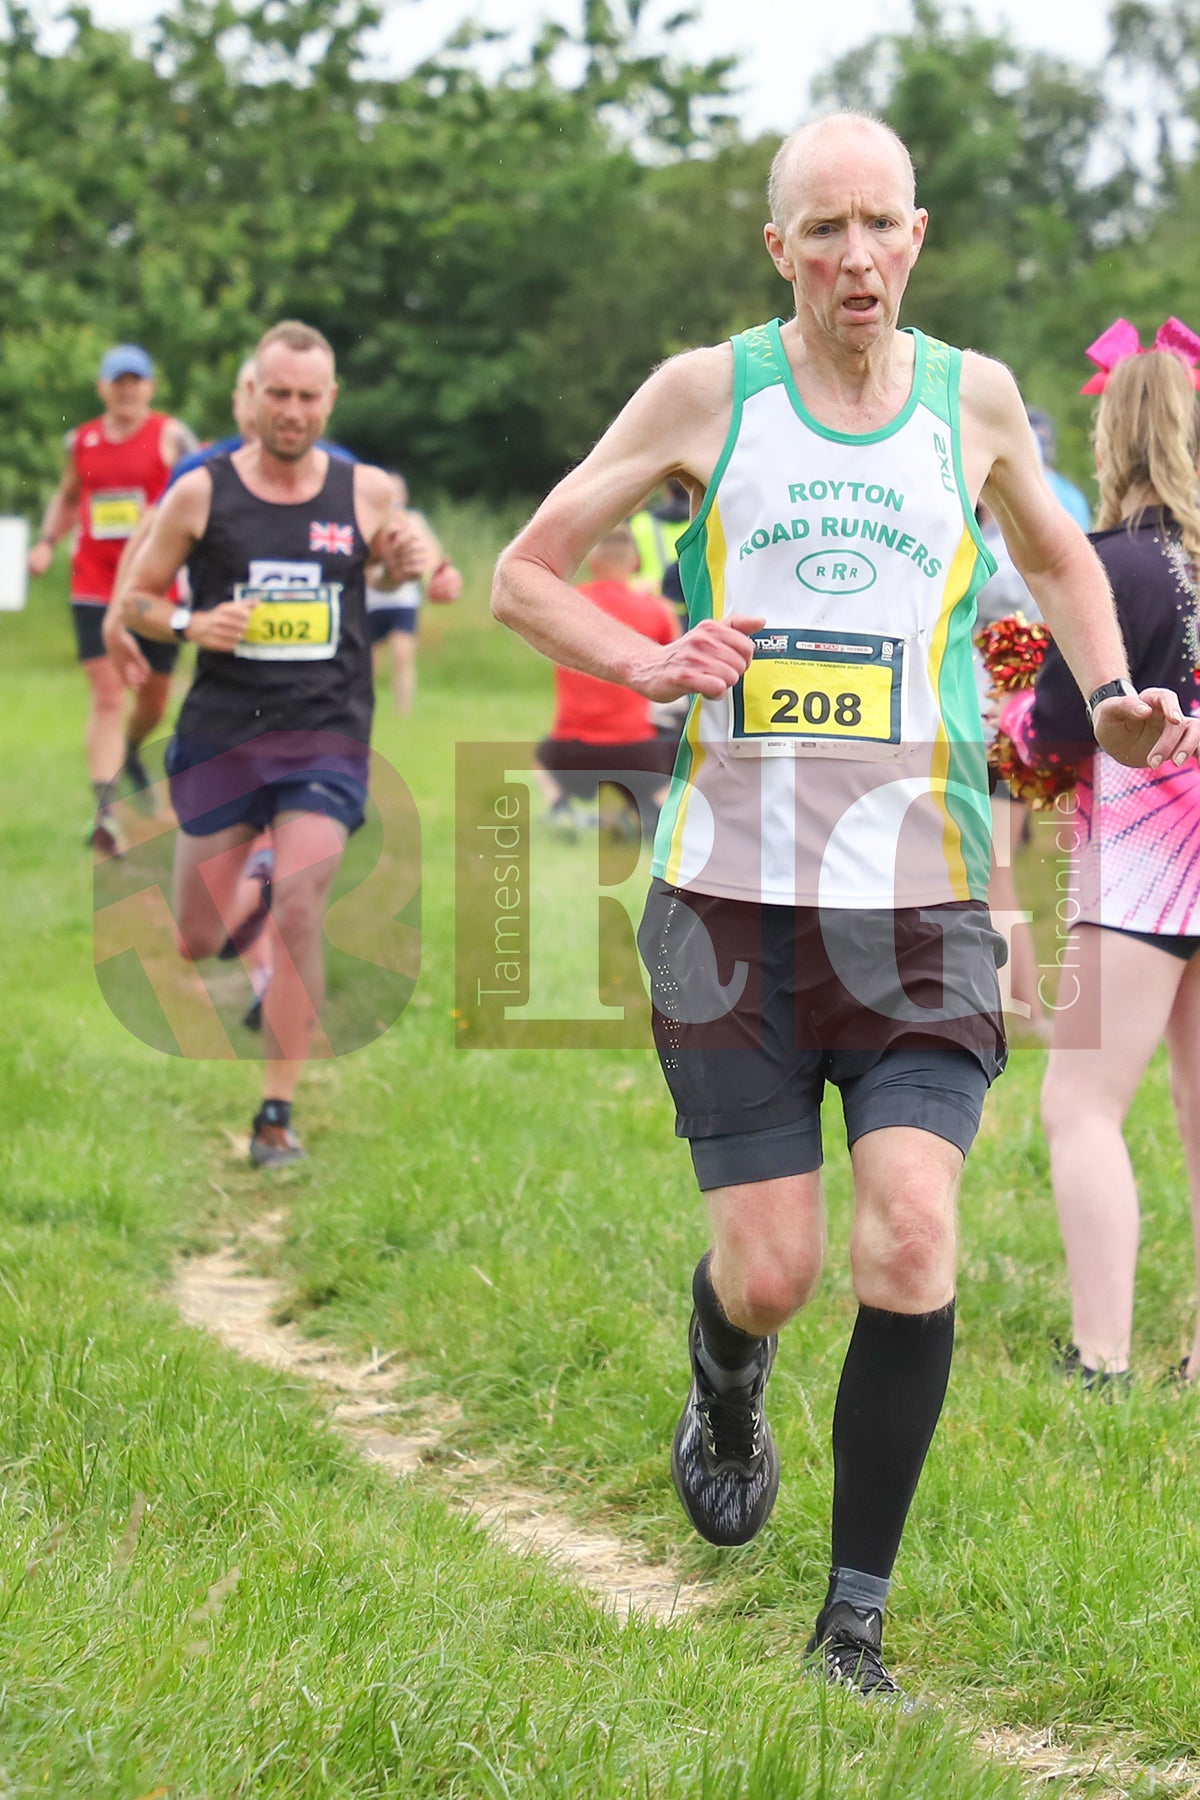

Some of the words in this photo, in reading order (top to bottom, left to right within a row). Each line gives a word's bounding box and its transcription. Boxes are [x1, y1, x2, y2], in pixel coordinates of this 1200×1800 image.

[933, 432, 955, 494] 2XU
[788, 480, 904, 512] ROYTON
[739, 519, 810, 561] ROAD
[821, 517, 943, 578] RUNNERS
[261, 620, 310, 640] 302
[755, 638, 788, 648] TOUR
[770, 689, 861, 726] 208
